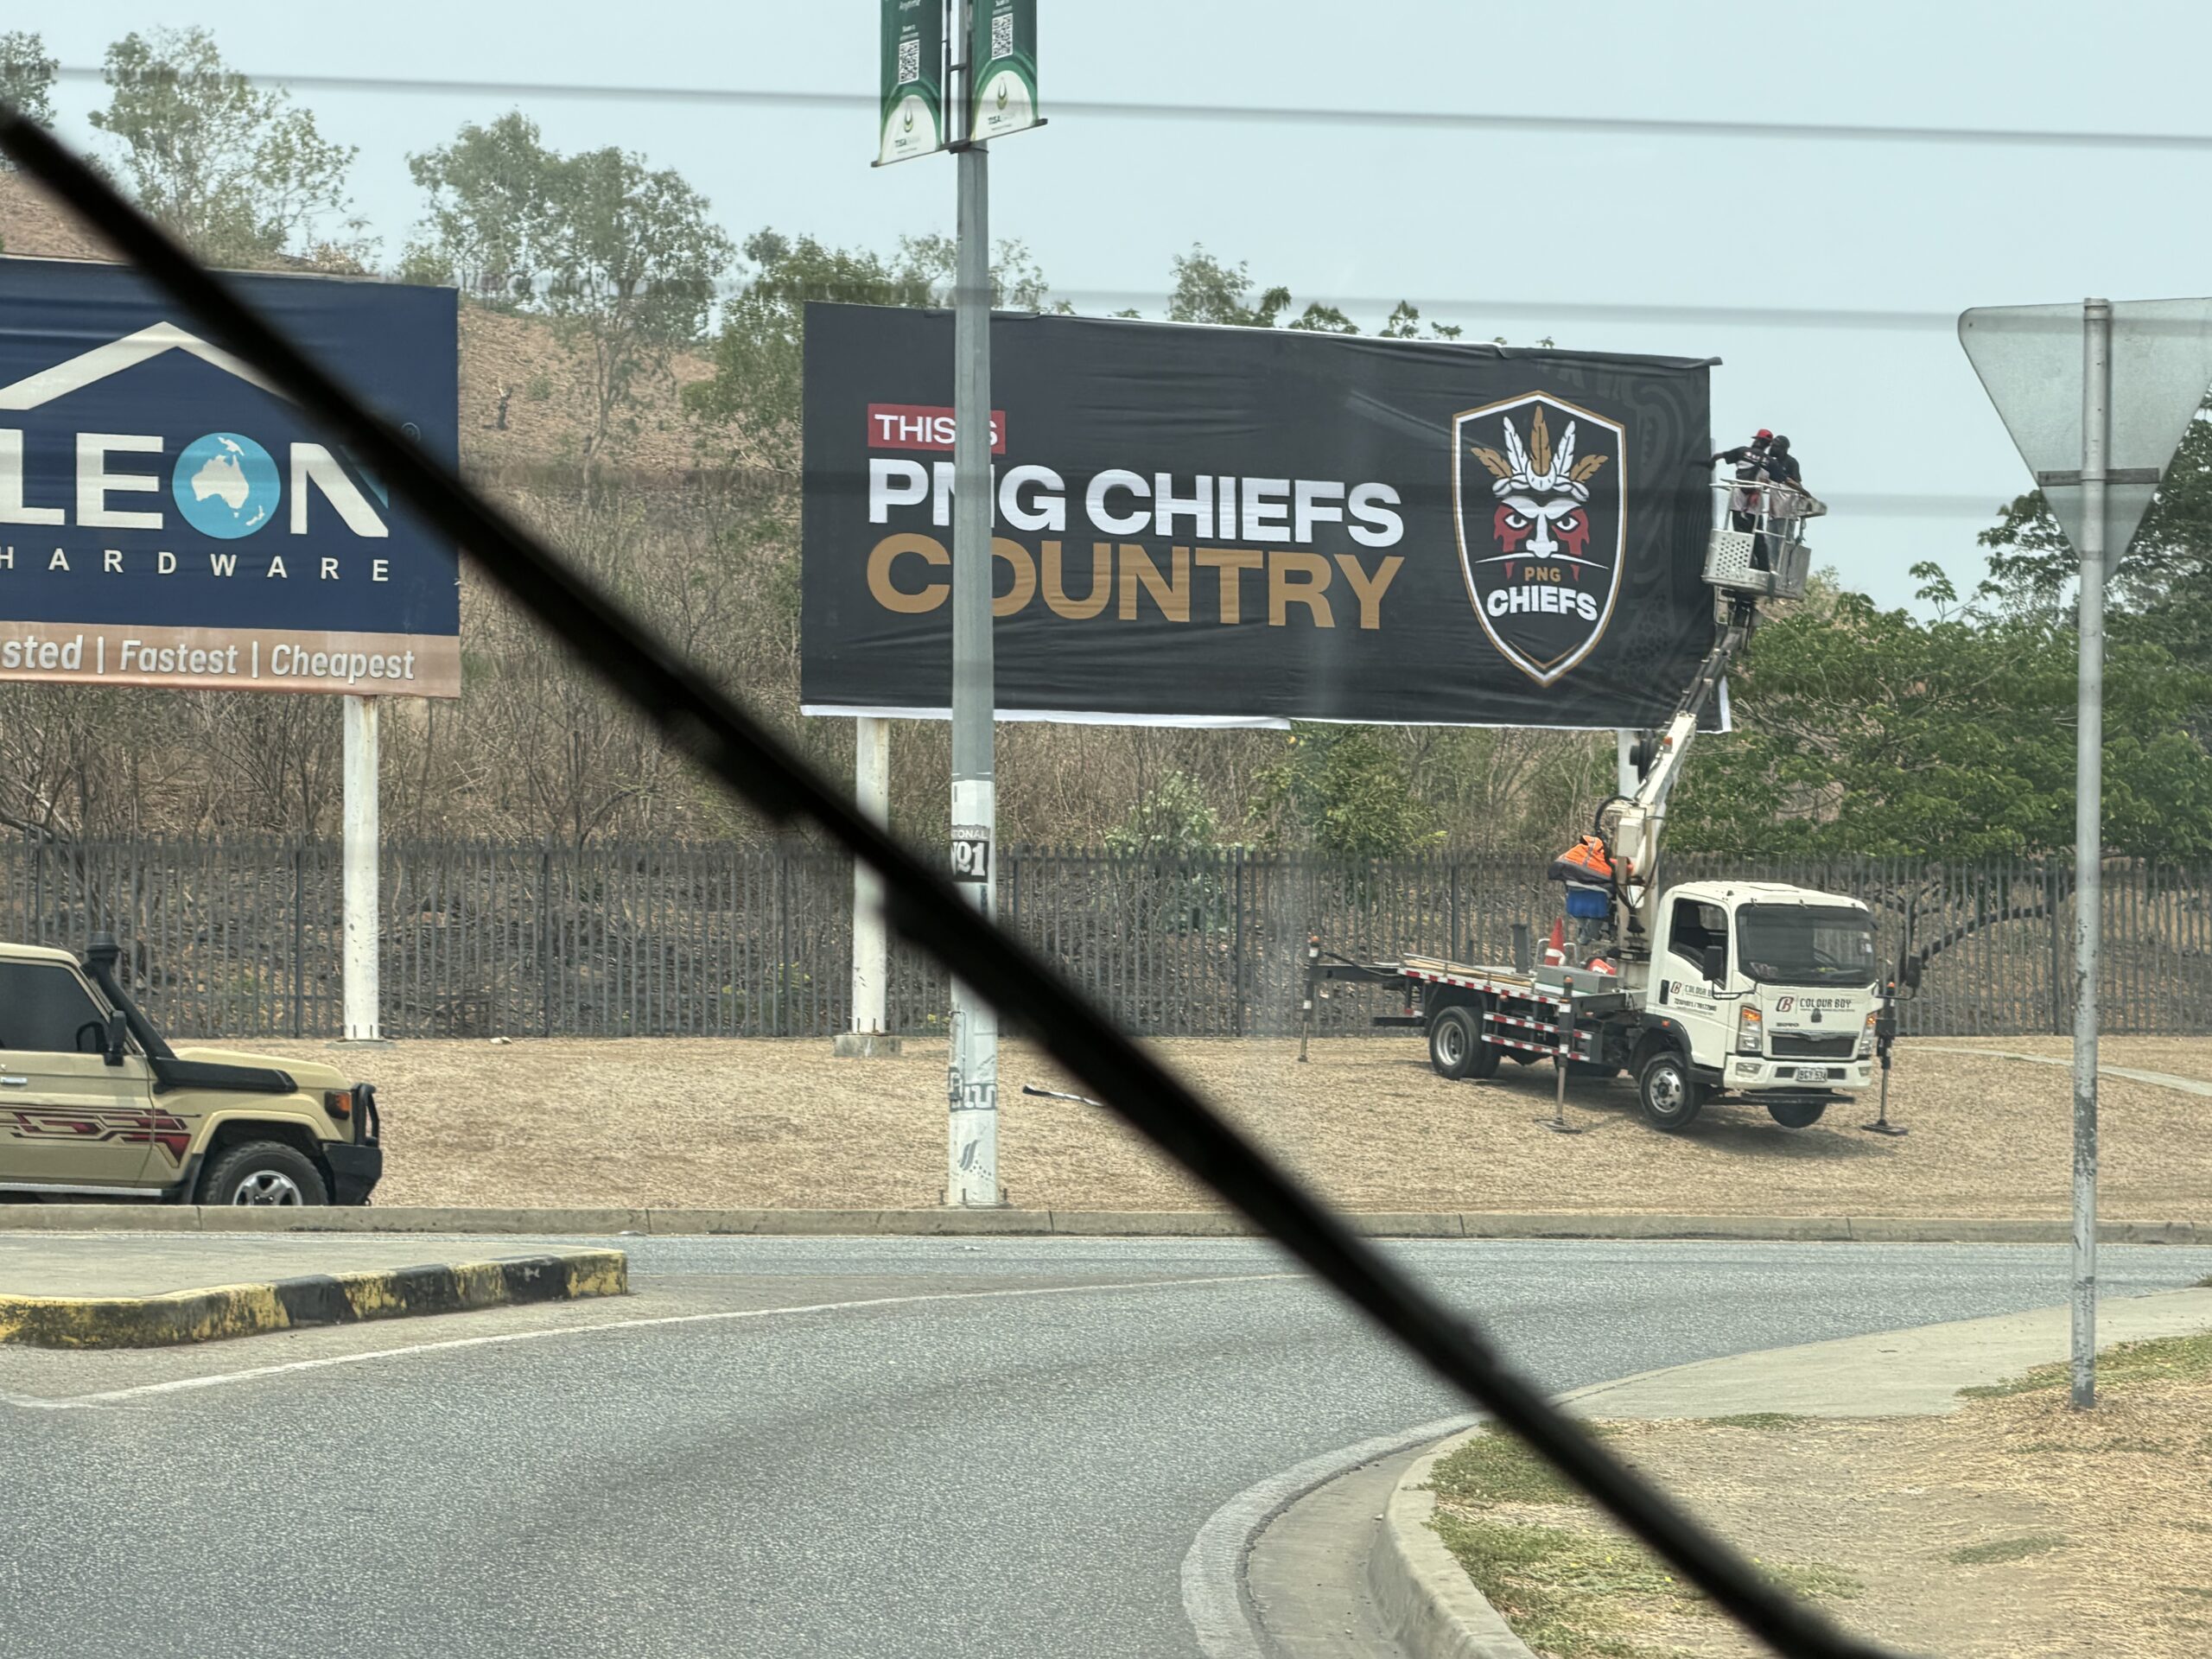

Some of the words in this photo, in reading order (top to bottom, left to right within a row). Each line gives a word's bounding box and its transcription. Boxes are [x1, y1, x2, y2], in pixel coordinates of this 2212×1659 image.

[874, 413, 955, 445] THIS
[1085, 468, 1405, 548] CHIEFS
[0, 546, 389, 582] HARDWARE
[867, 532, 1406, 630] COUNTRY
[1524, 566, 1561, 582] PNG
[1486, 585, 1598, 621] CHIEFS
[119, 639, 238, 675] Fastest
[270, 644, 416, 684] Cheapest
[1800, 998, 1832, 1008] COLOUR
[1834, 999, 1852, 1008] BOY
